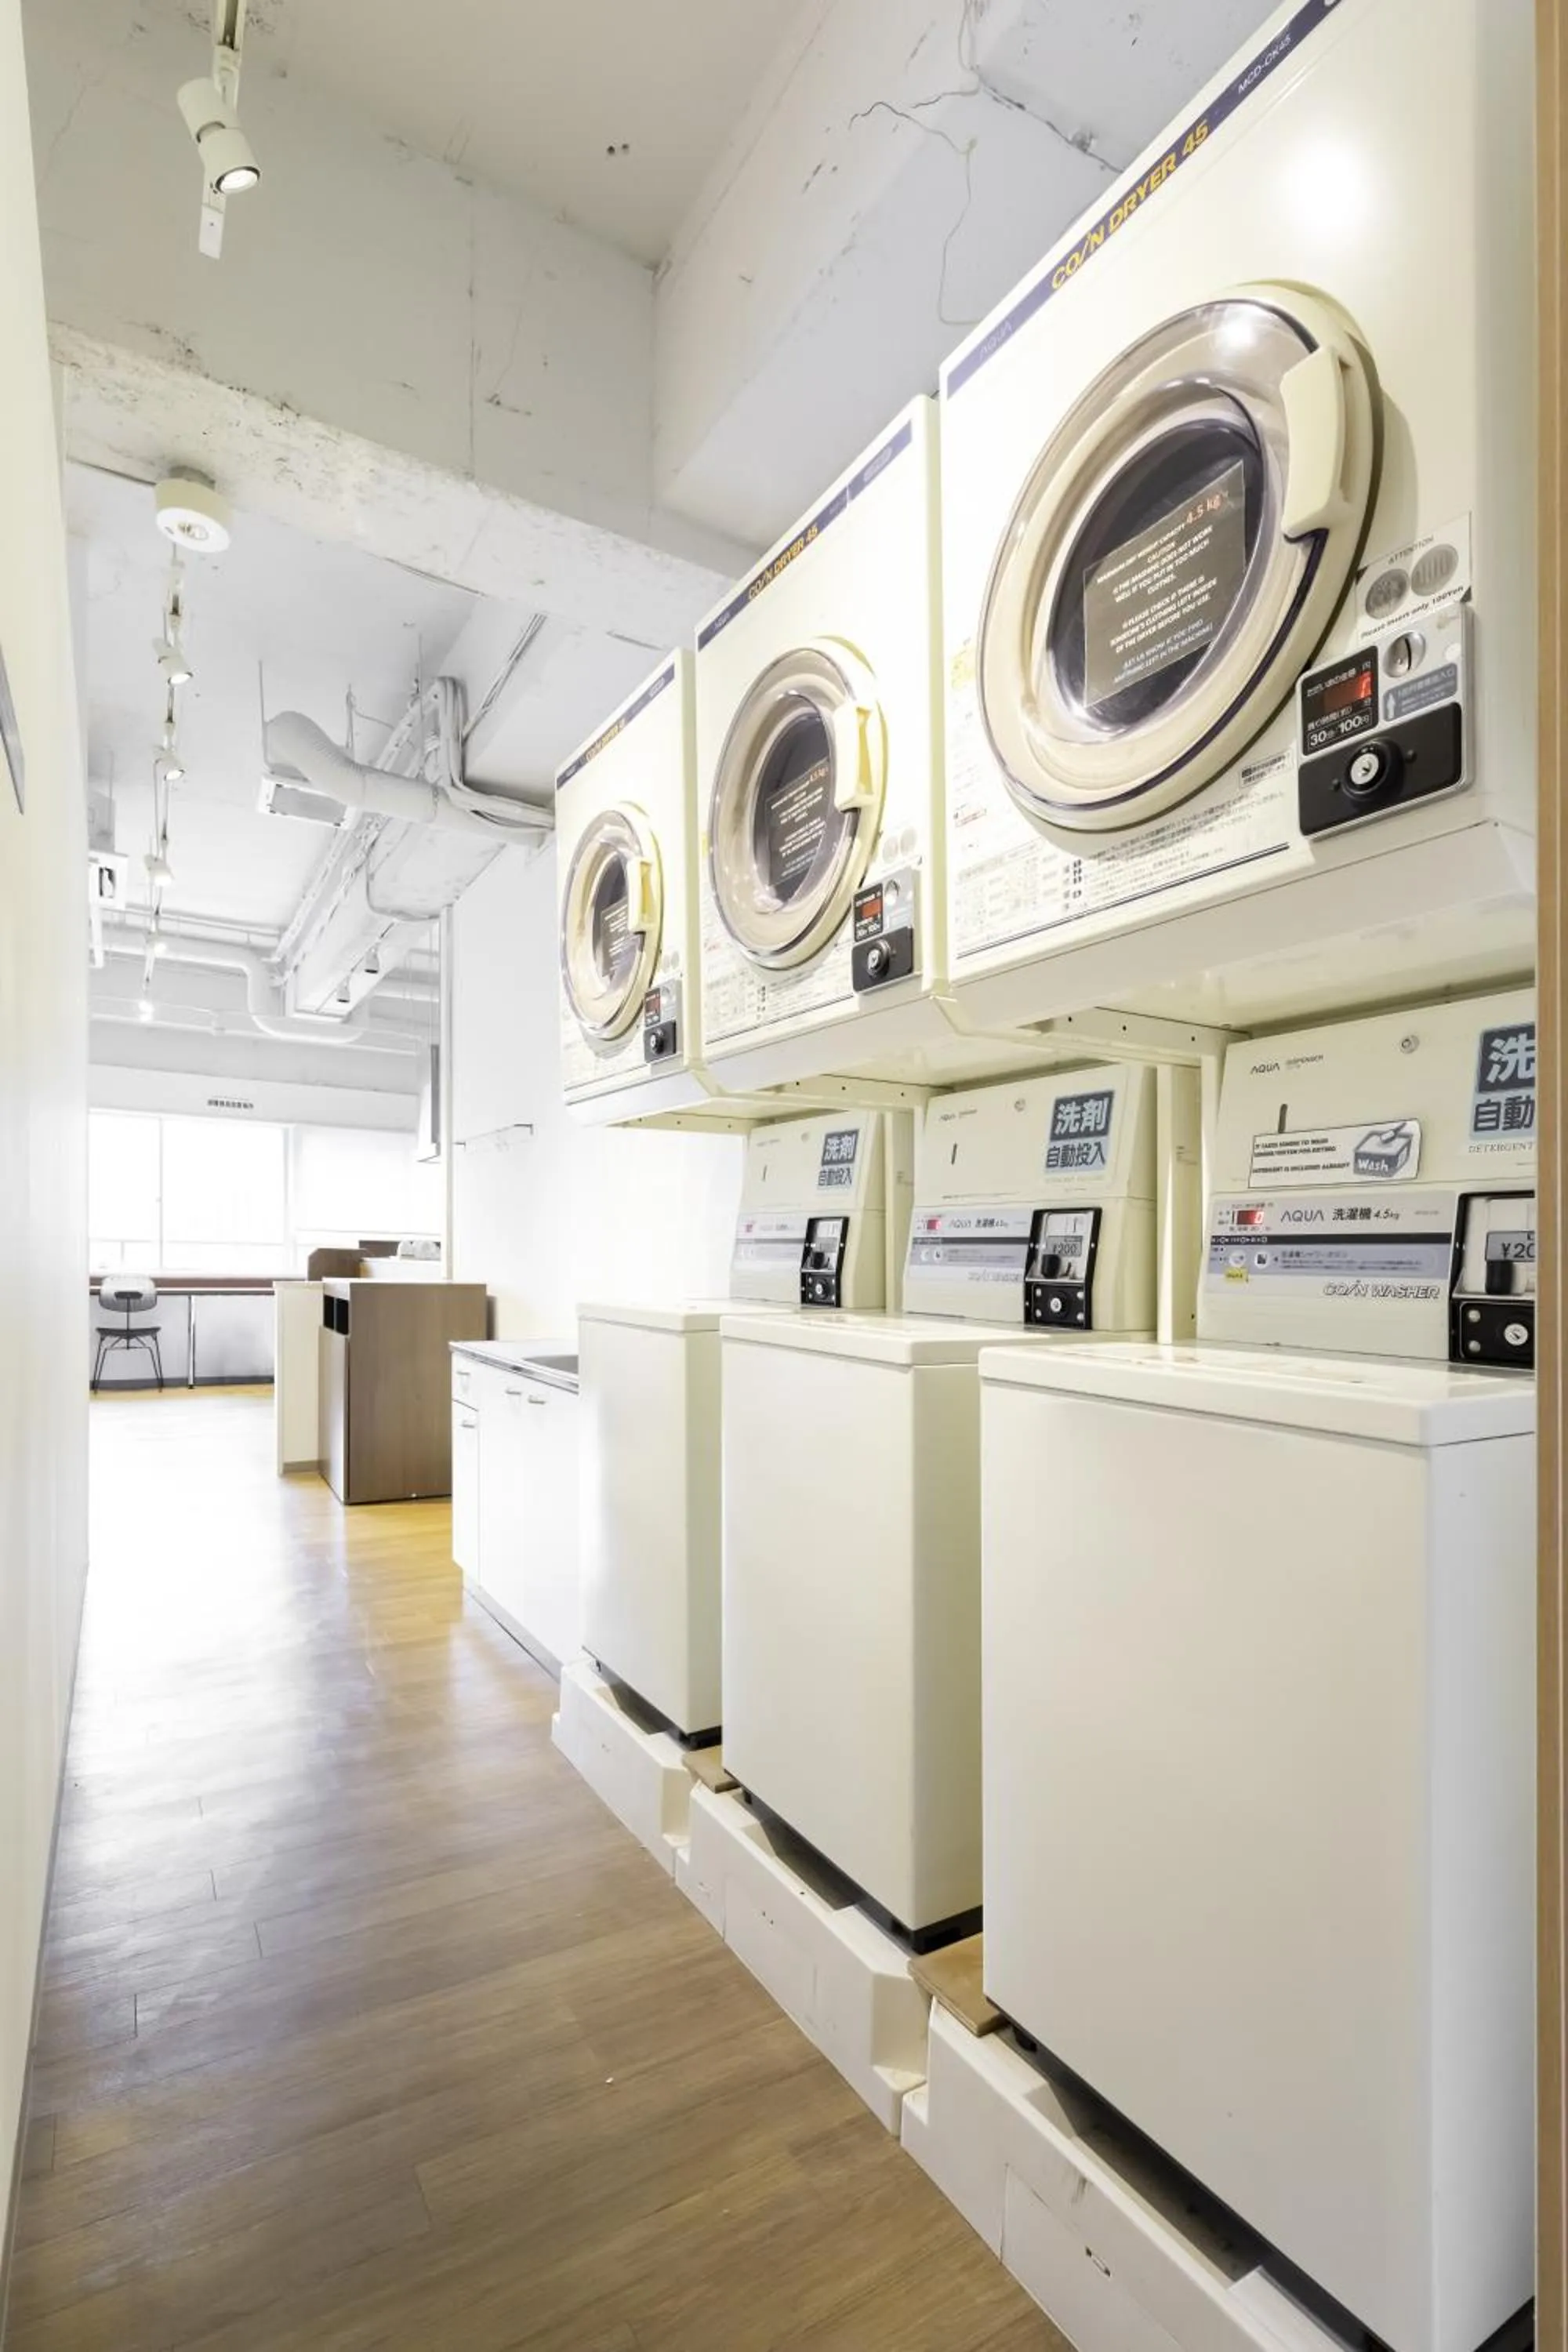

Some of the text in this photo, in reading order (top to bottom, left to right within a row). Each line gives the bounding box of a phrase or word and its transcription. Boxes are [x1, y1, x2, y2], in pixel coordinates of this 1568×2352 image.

[1109, 152, 1177, 234] DRYER
[1181, 119, 1209, 156] 45
[1185, 504, 1204, 524] 4.5
[1388, 535, 1434, 565] ATTENTION
[1411, 602, 1429, 614] only
[1250, 1062, 1280, 1075] AQUA
[1054, 1098, 1109, 1134] 洗剤
[1046, 1142, 1105, 1168] 自動投入
[1358, 1159, 1389, 1172] Wash
[1280, 1210, 1325, 1222] AQUA
[1332, 1207, 1372, 1221] 洗濯機
[1372, 1282, 1441, 1300] WASHER
